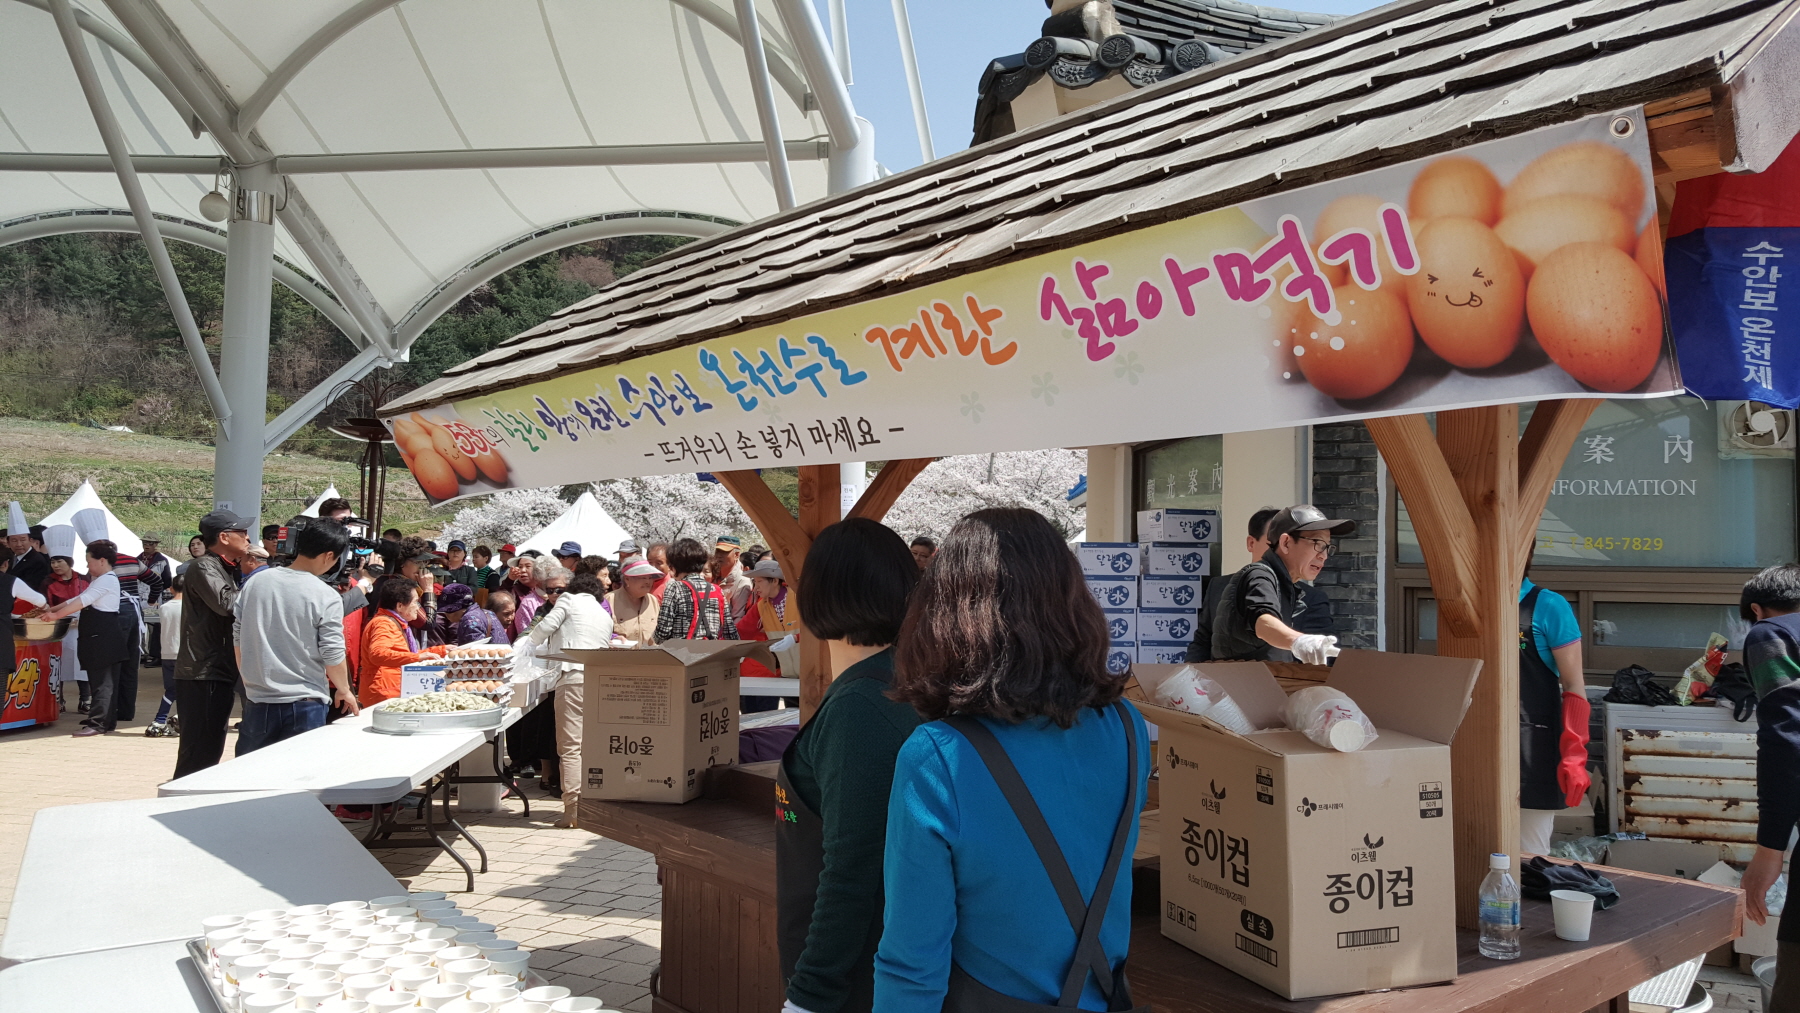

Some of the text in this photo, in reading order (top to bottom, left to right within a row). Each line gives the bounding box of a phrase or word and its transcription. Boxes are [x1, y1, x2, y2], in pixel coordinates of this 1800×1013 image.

[1739, 241, 1784, 390] 수안보 온천제
[618, 373, 713, 427] 수안보
[865, 295, 1018, 373] 계란
[736, 429, 759, 461] 손
[807, 415, 881, 454] 마세요
[609, 735, 655, 755] 종이컵
[700, 707, 730, 743] 종이컵
[1180, 816, 1249, 888] 종이컵
[1322, 866, 1414, 914] 종이컵
